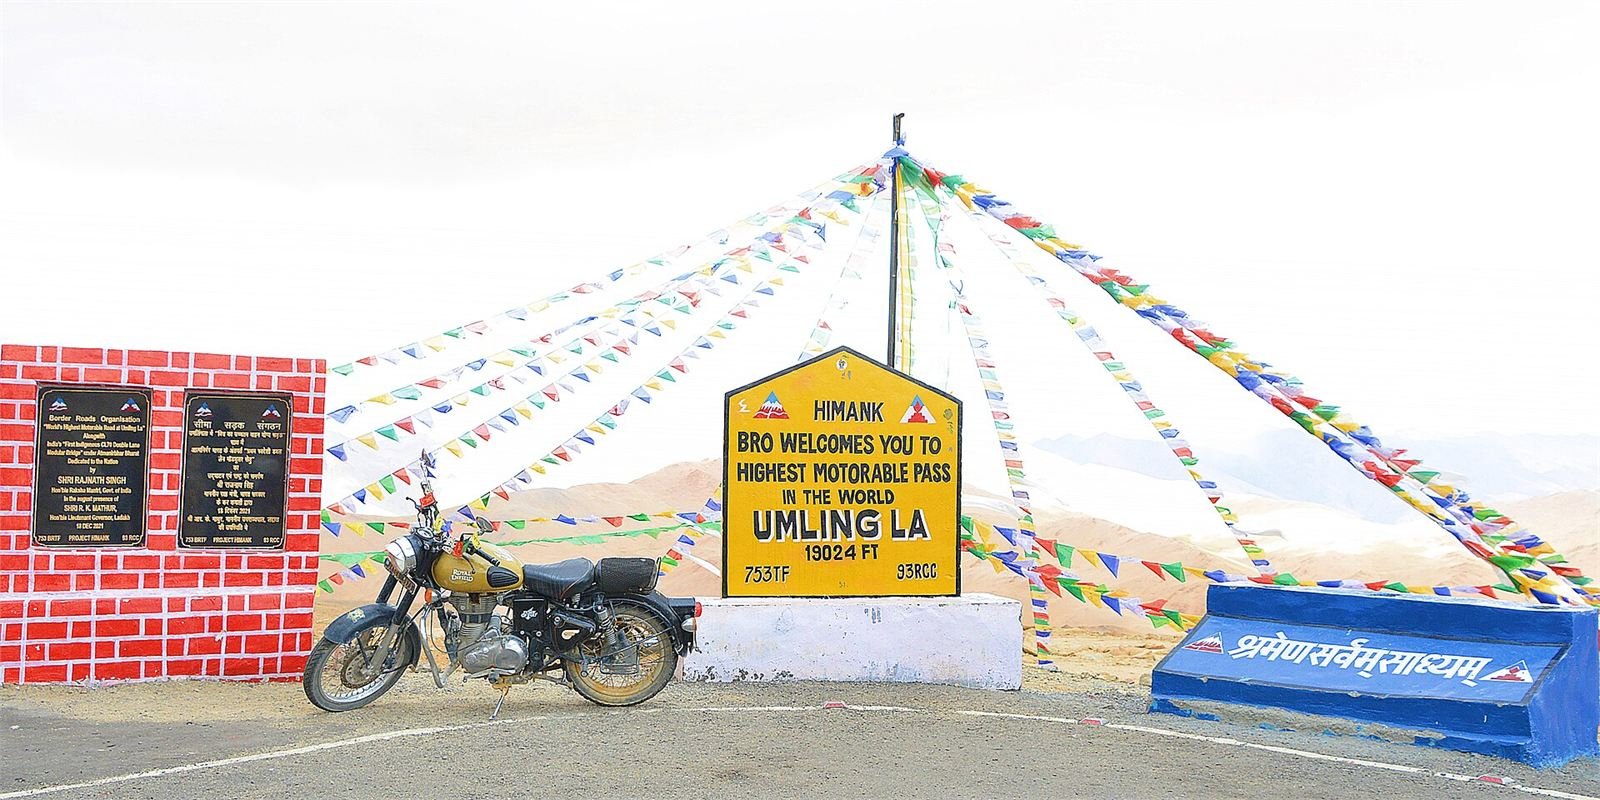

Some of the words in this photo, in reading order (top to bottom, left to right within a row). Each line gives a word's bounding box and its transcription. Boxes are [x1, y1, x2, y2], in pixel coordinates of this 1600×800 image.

[49, 414, 72, 422] Border
[100, 416, 140, 424] Organisation
[813, 400, 885, 423] HIMANK
[193, 418, 212, 429] सीमा
[224, 421, 246, 430] सड़क
[256, 420, 282, 431] संगठन
[737, 431, 774, 453] BRO
[779, 432, 875, 454] WELCOMES
[878, 434, 914, 455] YOU
[920, 436, 942, 455] TO
[89, 466, 97, 474] by
[737, 462, 807, 483] HIGHEST
[813, 462, 908, 484] MOTORABLE
[914, 462, 951, 484] PASS
[58, 476, 74, 484] SHRI
[75, 476, 104, 484] RAJNATH
[106, 476, 127, 484] SINGH
[782, 489, 796, 504] IN
[802, 489, 831, 504] THE
[838, 489, 895, 504] WORLD
[753, 509, 883, 542] UMLING
[890, 509, 932, 542] LA
[805, 544, 856, 561] 19024
[862, 544, 879, 560] FT
[744, 565, 790, 583] 753TF
[896, 563, 938, 580] 93RCC
